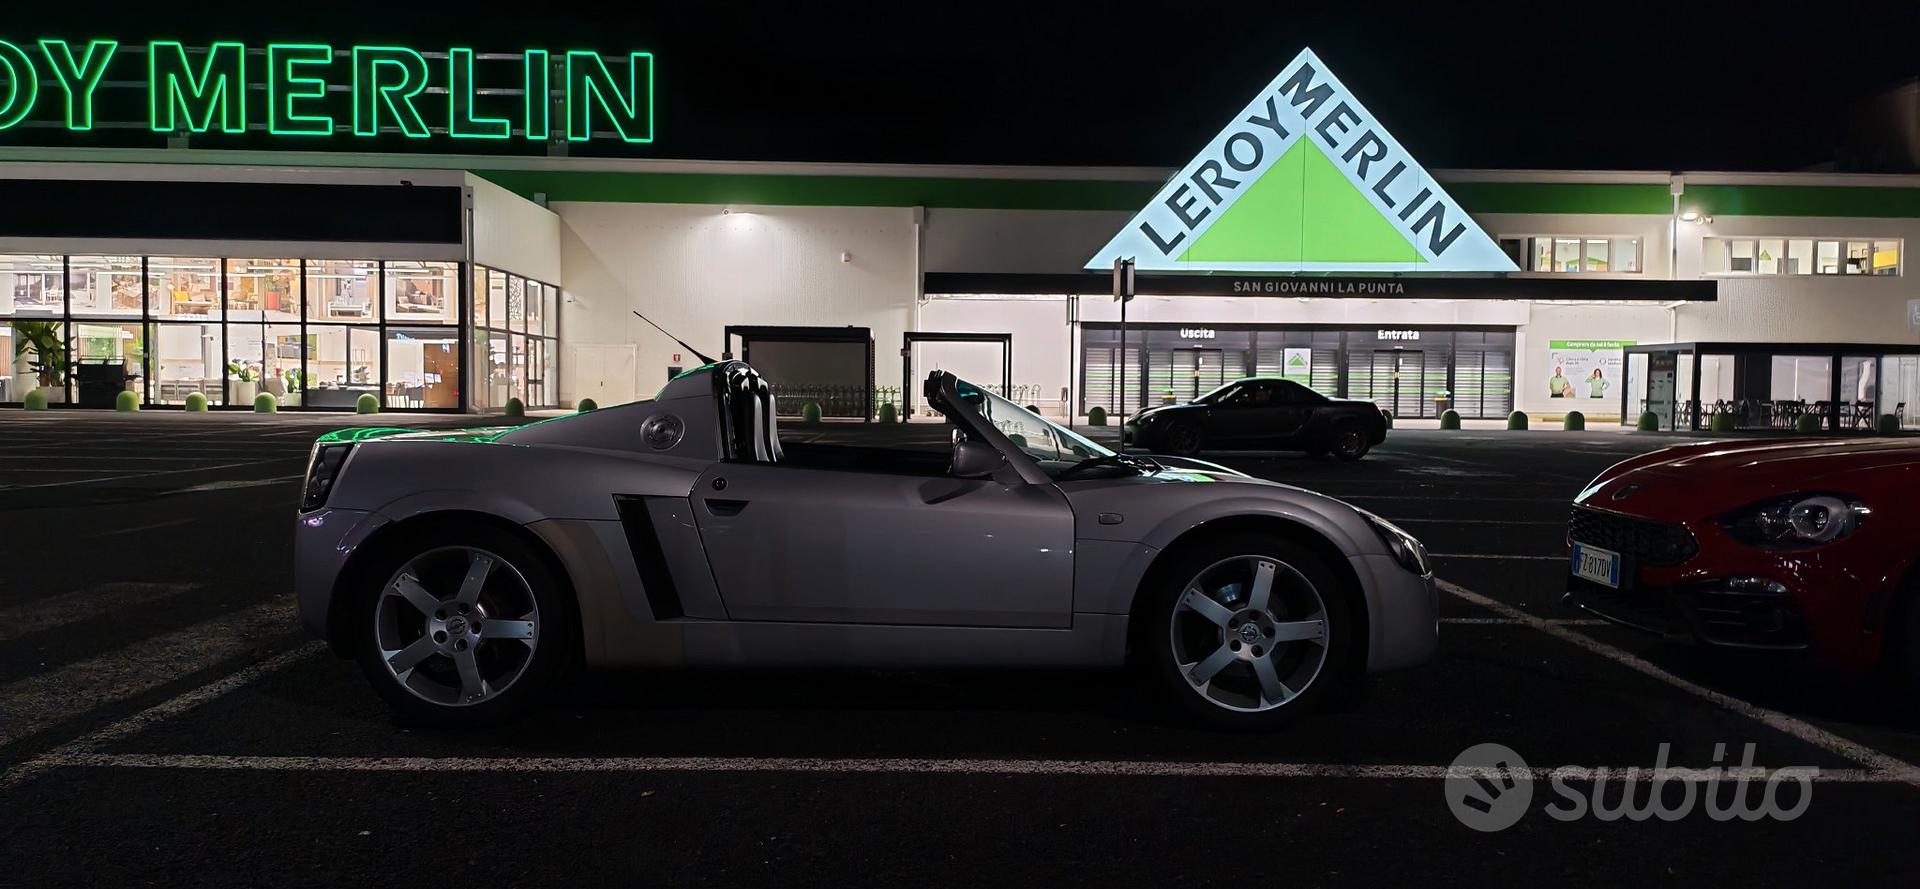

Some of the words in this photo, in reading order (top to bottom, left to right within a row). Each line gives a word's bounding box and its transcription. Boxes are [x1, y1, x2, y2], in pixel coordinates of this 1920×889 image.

[149, 39, 655, 144] MERLIN
[1139, 95, 1290, 257] LEROY
[1277, 61, 1467, 258] MERLIN
[1233, 281, 1261, 293] SAN
[1265, 281, 1335, 294] GIOVANNI
[1338, 282, 1355, 294] LA
[1358, 282, 1404, 294] PUNTA
[1180, 328, 1215, 340] Uscita
[1377, 329, 1420, 340] Entrata
